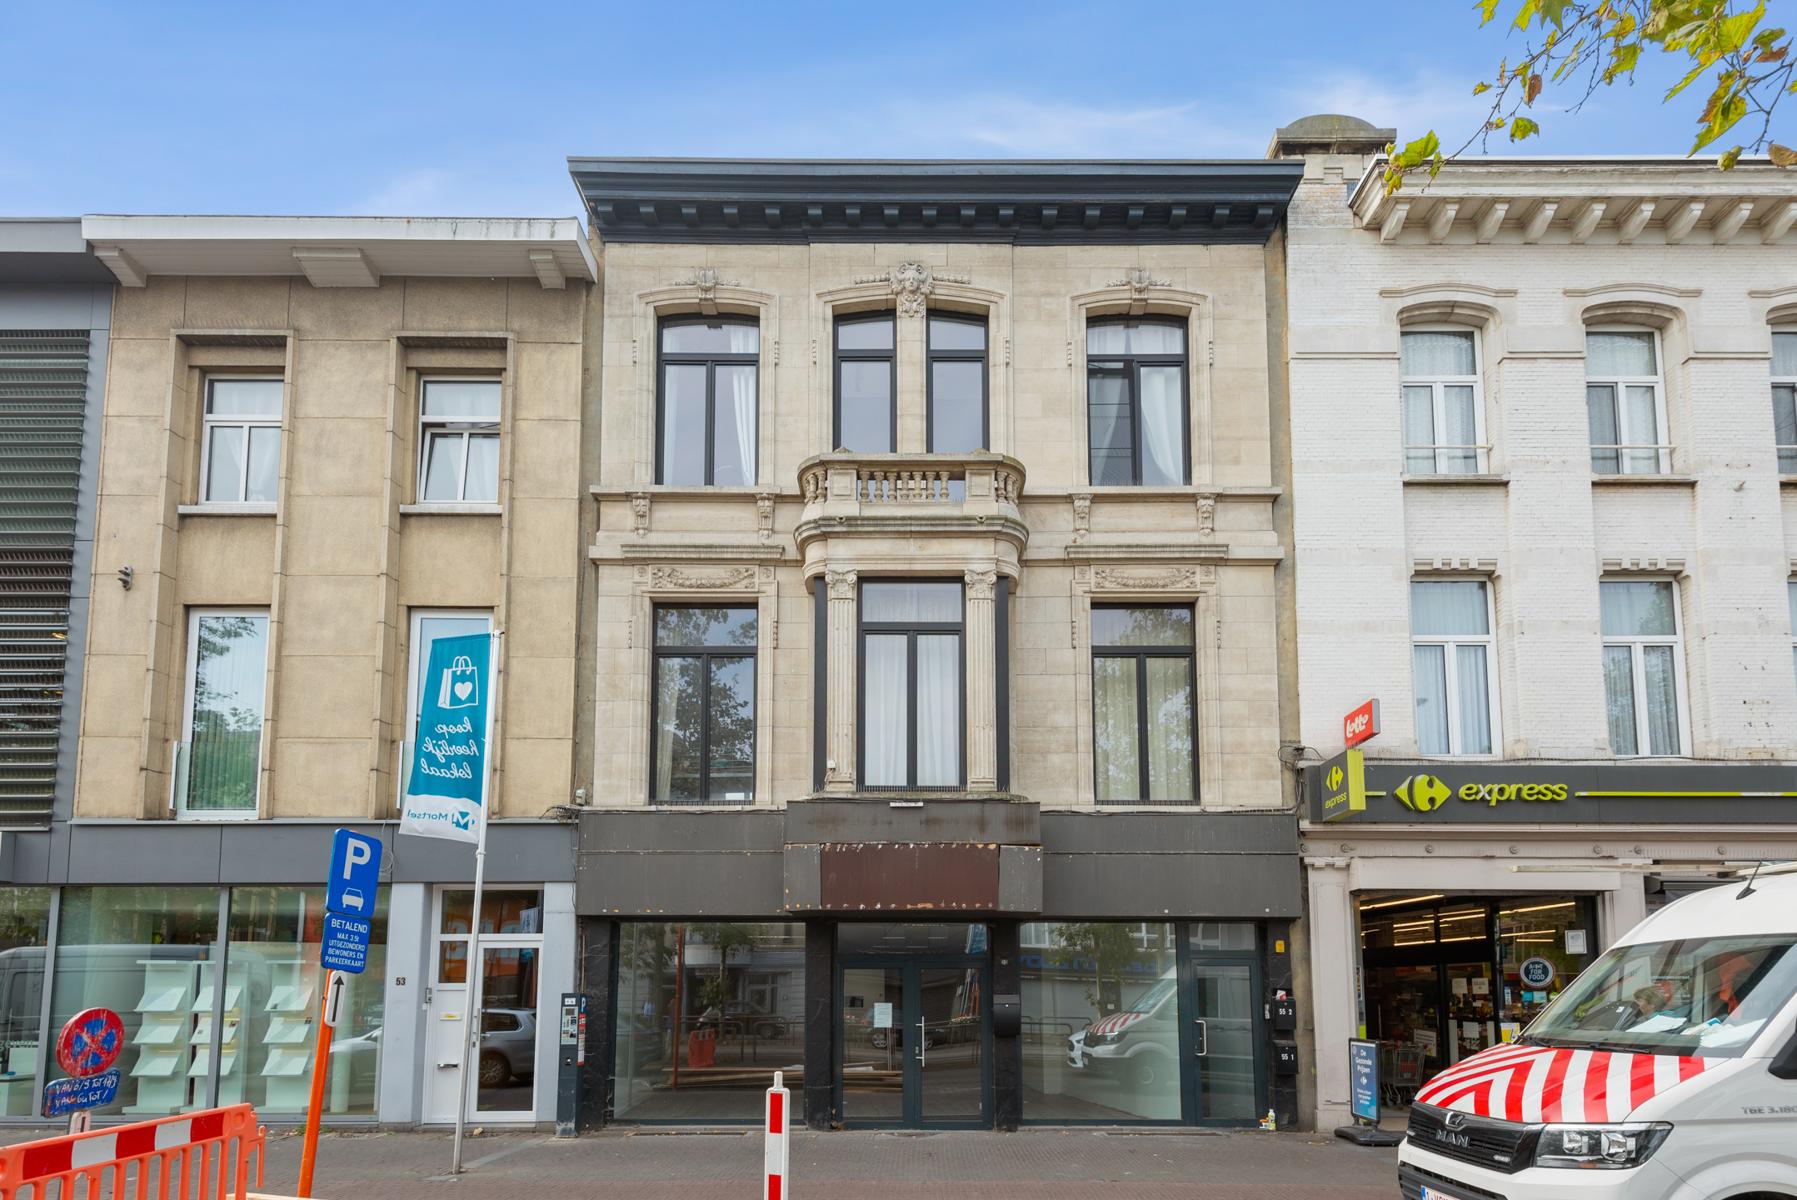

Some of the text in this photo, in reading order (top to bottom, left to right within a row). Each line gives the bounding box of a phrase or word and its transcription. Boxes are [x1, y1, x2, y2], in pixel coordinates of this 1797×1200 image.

[1325, 793, 1347, 809] express
[1458, 783, 1568, 806] express
[343, 837, 371, 880] P
[331, 918, 368, 933] BETALEND
[336, 932, 349, 940] MAX
[328, 939, 366, 951] UITGEZONDERD
[327, 947, 356, 959] BEWONERS
[324, 955, 364, 967] PARKEERKAART
[395, 977, 406, 985] 53
[1436, 1129, 1470, 1148] MAN
